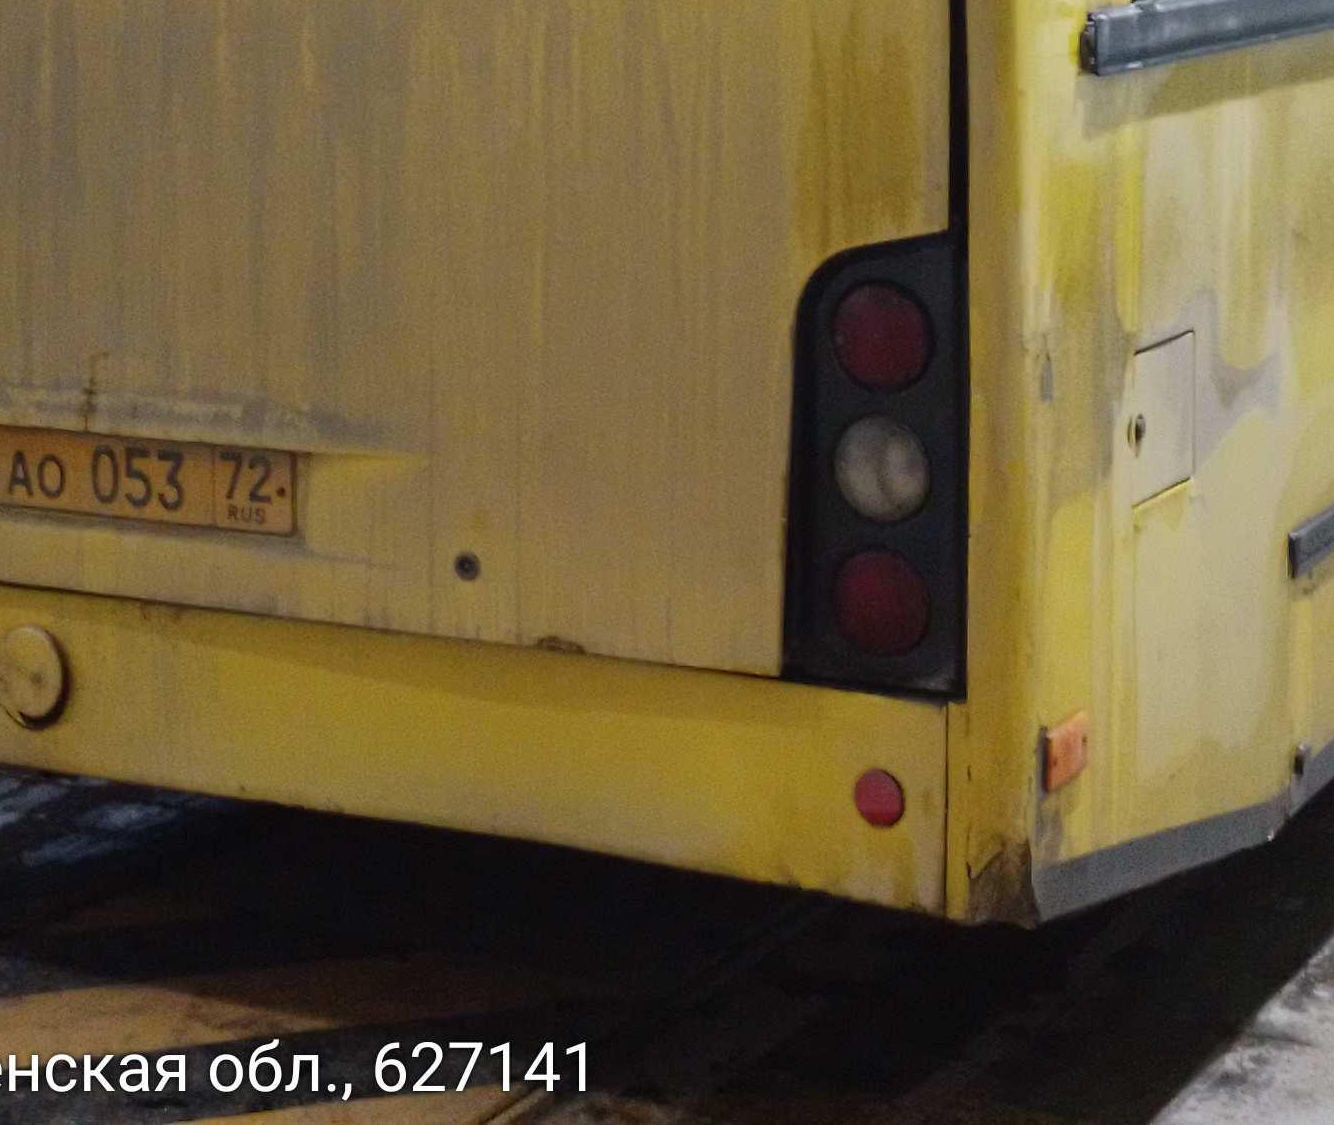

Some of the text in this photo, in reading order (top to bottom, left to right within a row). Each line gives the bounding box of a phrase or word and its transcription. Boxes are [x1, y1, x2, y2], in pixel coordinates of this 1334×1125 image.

[91, 443, 186, 512] 053
[219, 450, 273, 504] 72
[226, 503, 267, 526] RUS
